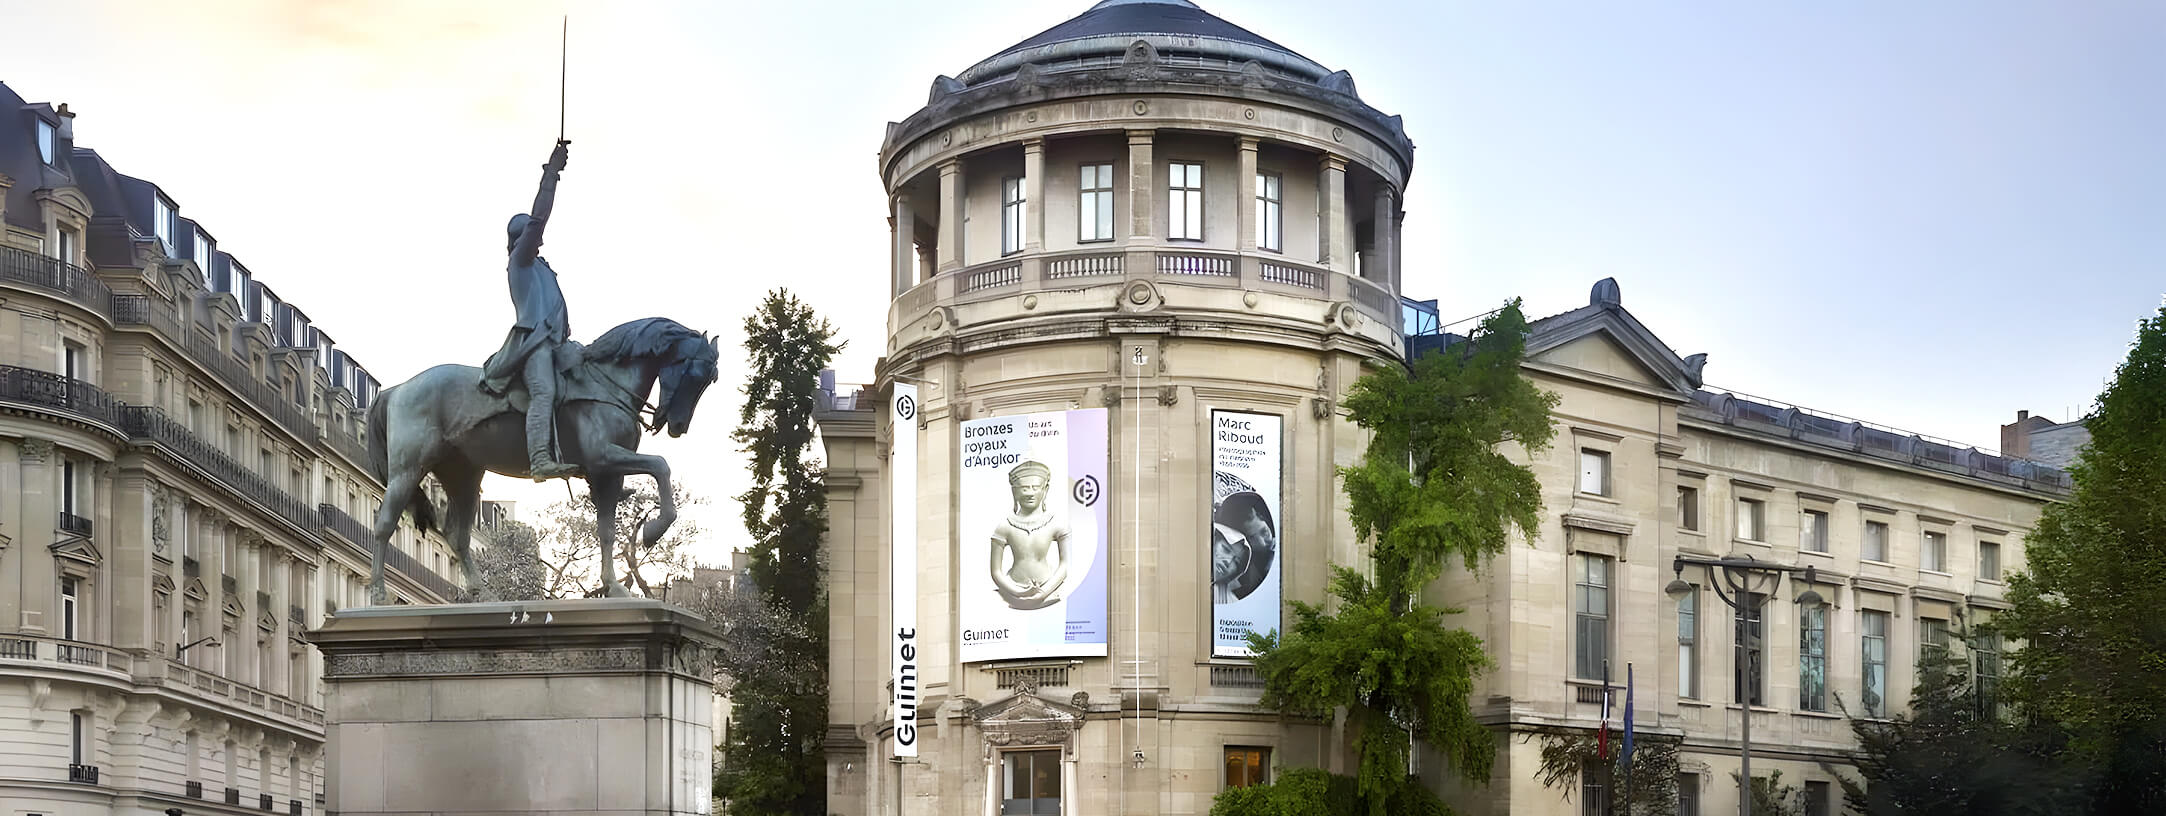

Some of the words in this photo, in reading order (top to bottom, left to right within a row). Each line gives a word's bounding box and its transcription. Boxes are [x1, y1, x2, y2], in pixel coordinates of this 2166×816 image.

[964, 423, 1013, 438] Bronzes
[1218, 417, 1251, 430] Marc
[1218, 430, 1263, 445] Riboud
[964, 439, 1007, 454] royaux
[964, 453, 1021, 468] d'Angkor
[963, 628, 1010, 641] Guimet
[897, 627, 915, 746] Guimet
